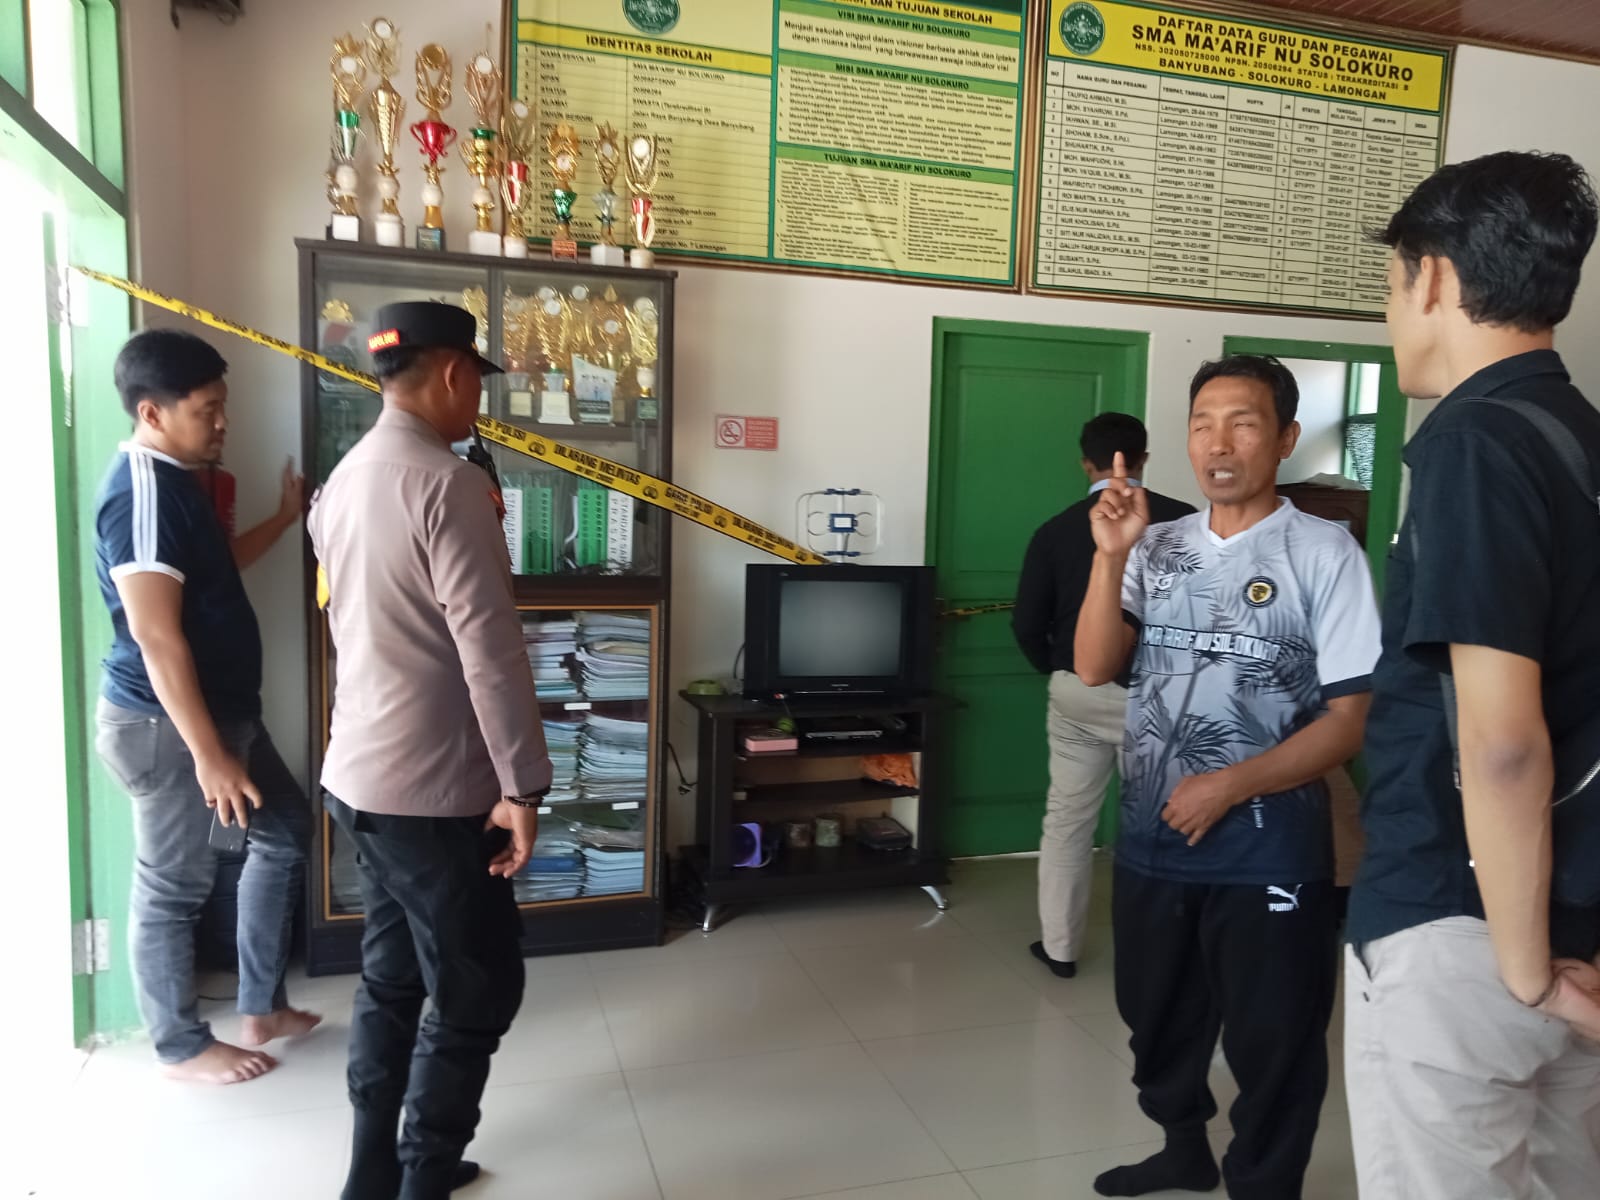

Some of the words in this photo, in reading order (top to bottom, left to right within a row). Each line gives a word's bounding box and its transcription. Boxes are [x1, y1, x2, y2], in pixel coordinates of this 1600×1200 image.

[838, 10, 854, 20] VISI
[857, 12, 874, 22] SMA
[876, 16, 908, 28] MA'ARIF
[912, 22, 924, 31] NU
[926, 25, 970, 38] SOLOKURO
[897, 1, 940, 16] TUJUAN
[944, 8, 992, 24] SEKOLAH
[586, 34, 652, 54] IDENTITAS
[656, 45, 712, 62] SEKOLAH
[784, 20, 814, 32] Menjadi
[816, 26, 844, 37] sekolah
[846, 31, 871, 42] unggul
[872, 35, 894, 45] dalam
[896, 40, 924, 50] visioner
[926, 43, 956, 54] berbasis
[958, 48, 980, 58] akhlak
[792, 34, 820, 44] dengan
[822, 38, 848, 48] nuansa
[876, 47, 893, 56] yang
[895, 48, 938, 61] berwawasan
[940, 57, 964, 67] aswaja
[966, 60, 995, 70] indikator
[996, 64, 1009, 72] visi
[1132, 24, 1176, 46] SMA
[1185, 33, 1267, 58] MA'ARIF
[1275, 48, 1302, 64] NU
[1310, 53, 1414, 82] SOLOKURO
[1158, 15, 1214, 34] DAFTAR
[1218, 25, 1254, 40] DATA
[1258, 32, 1296, 48] GURU
[1302, 39, 1328, 52] DAN
[1333, 44, 1392, 63] PEGAWAI
[836, 63, 854, 73] MISI
[856, 66, 874, 76] SMA
[876, 70, 908, 80] MA'ARIF
[911, 74, 922, 82] NU
[926, 76, 969, 90] SOLOKURO
[1159, 58, 1236, 78] BANYUBANG
[1248, 71, 1312, 89] SOLOKURO
[1323, 83, 1387, 100] LAMONGAN
[1297, 68, 1328, 79] STATUS
[1336, 74, 1399, 90] TERAKREDITASI
[824, 153, 858, 165] TUJUAN
[860, 158, 877, 167] SMA
[914, 164, 926, 173] NU
[928, 166, 972, 178] SOLOKURO
[494, 422, 527, 442] POLISI
[554, 444, 598, 468] DILARANG
[600, 459, 641, 485] MELINTAS
[1268, 902, 1295, 912] PUMA
